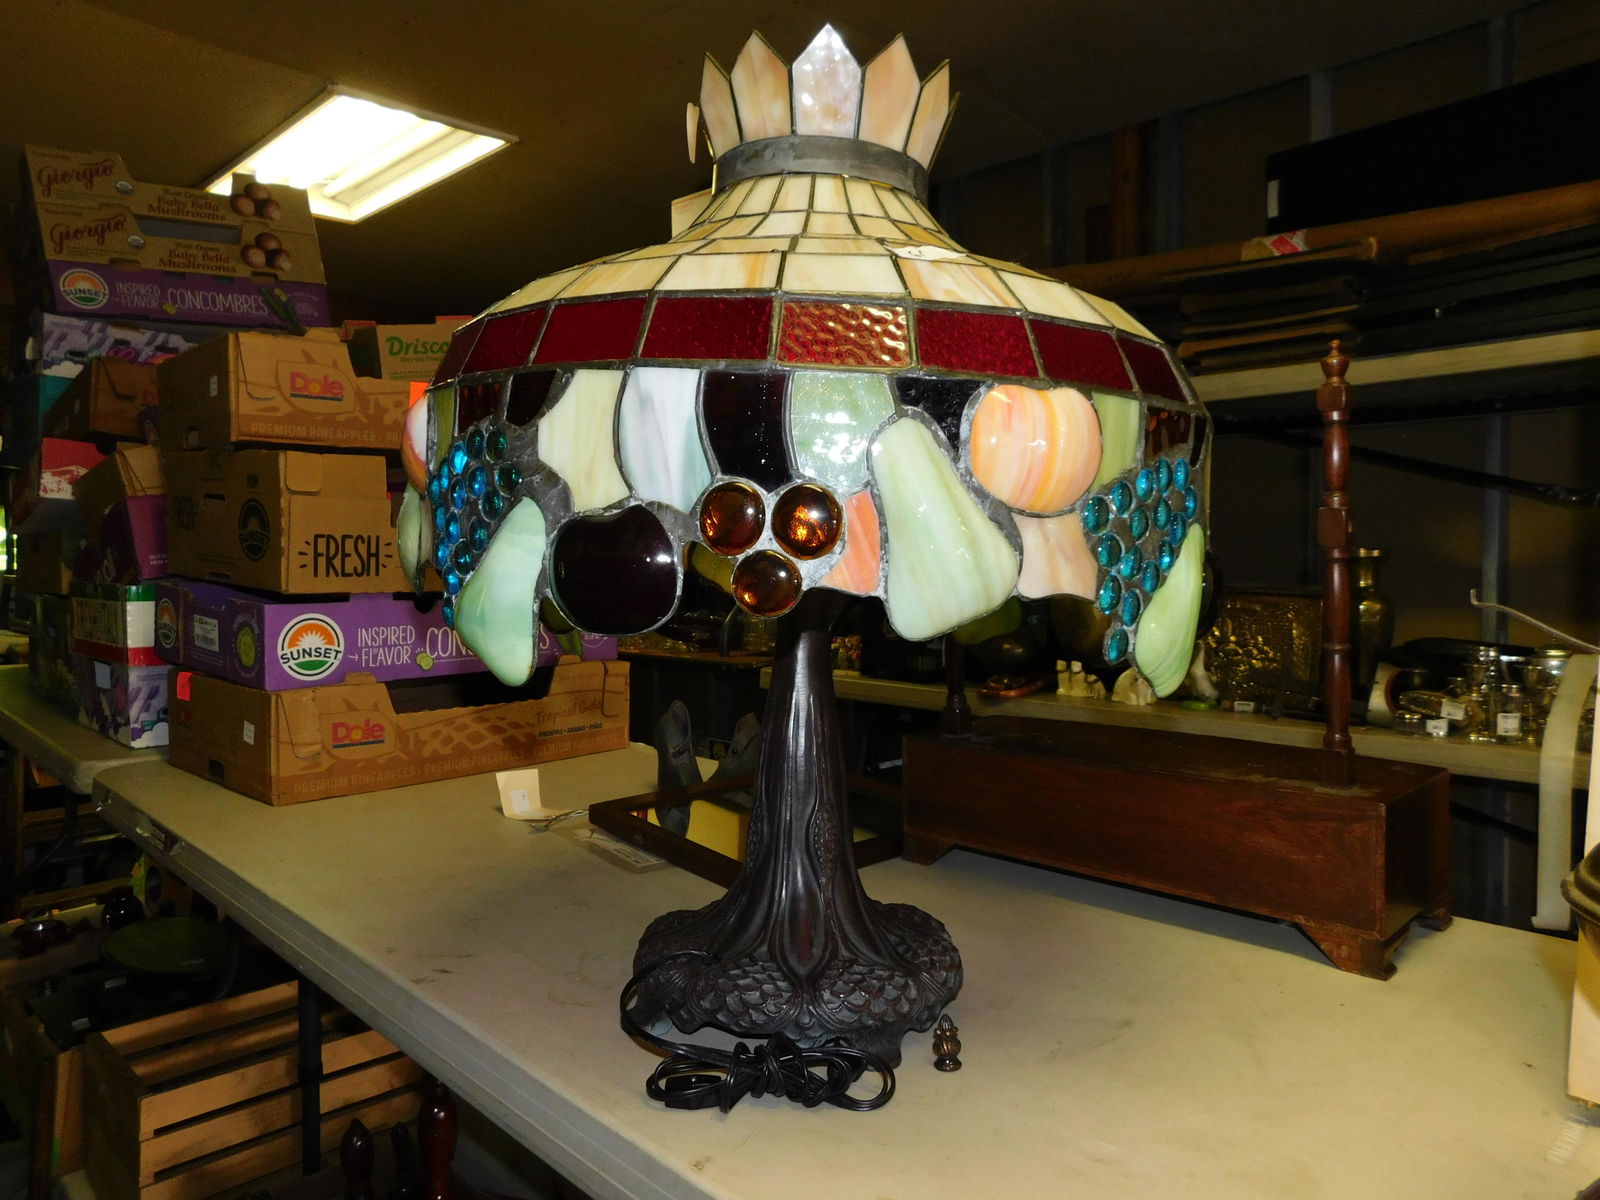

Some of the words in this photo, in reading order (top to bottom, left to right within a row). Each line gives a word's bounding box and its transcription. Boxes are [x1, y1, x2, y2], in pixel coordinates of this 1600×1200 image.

[147, 204, 227, 221] Mushrooms
[159, 258, 237, 273] Mushrooms
[168, 249, 197, 261] Baby
[202, 253, 230, 264] Bello
[62, 287, 108, 299] SUNSET
[116, 282, 160, 297] INSPIRED
[121, 296, 160, 309] FLAVOR
[167, 288, 268, 315] CONCOMBRES
[386, 336, 450, 356] Drisco
[290, 371, 345, 396] Dole
[251, 424, 306, 437] PREMIUM
[310, 427, 376, 442] PINEAPPLES
[313, 533, 380, 578] FRESH
[358, 625, 416, 648] INSPIRED
[281, 647, 342, 665] SUNSET
[362, 646, 412, 668] FLAVOR
[332, 718, 386, 744] Dole
[294, 776, 349, 794] PREMIUM
[352, 766, 416, 786] PINEAPPLES
[424, 757, 472, 776] PREMIUM
